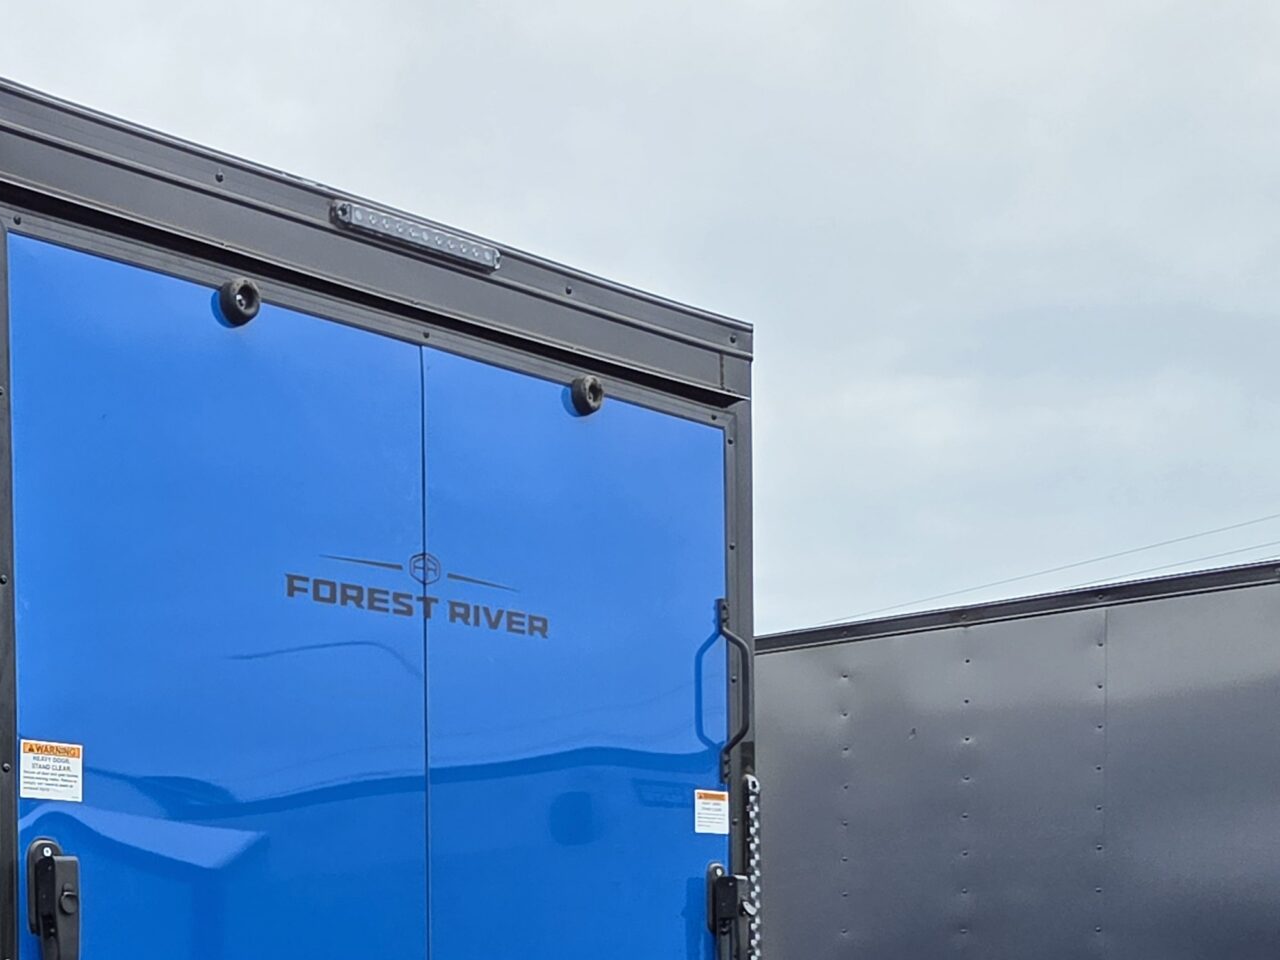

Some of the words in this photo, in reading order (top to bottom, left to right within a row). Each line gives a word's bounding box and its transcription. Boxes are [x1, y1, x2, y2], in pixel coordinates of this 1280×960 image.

[284, 573, 439, 619] FOREST
[447, 600, 549, 639] RIVER
[36, 744, 76, 756] WARNING
